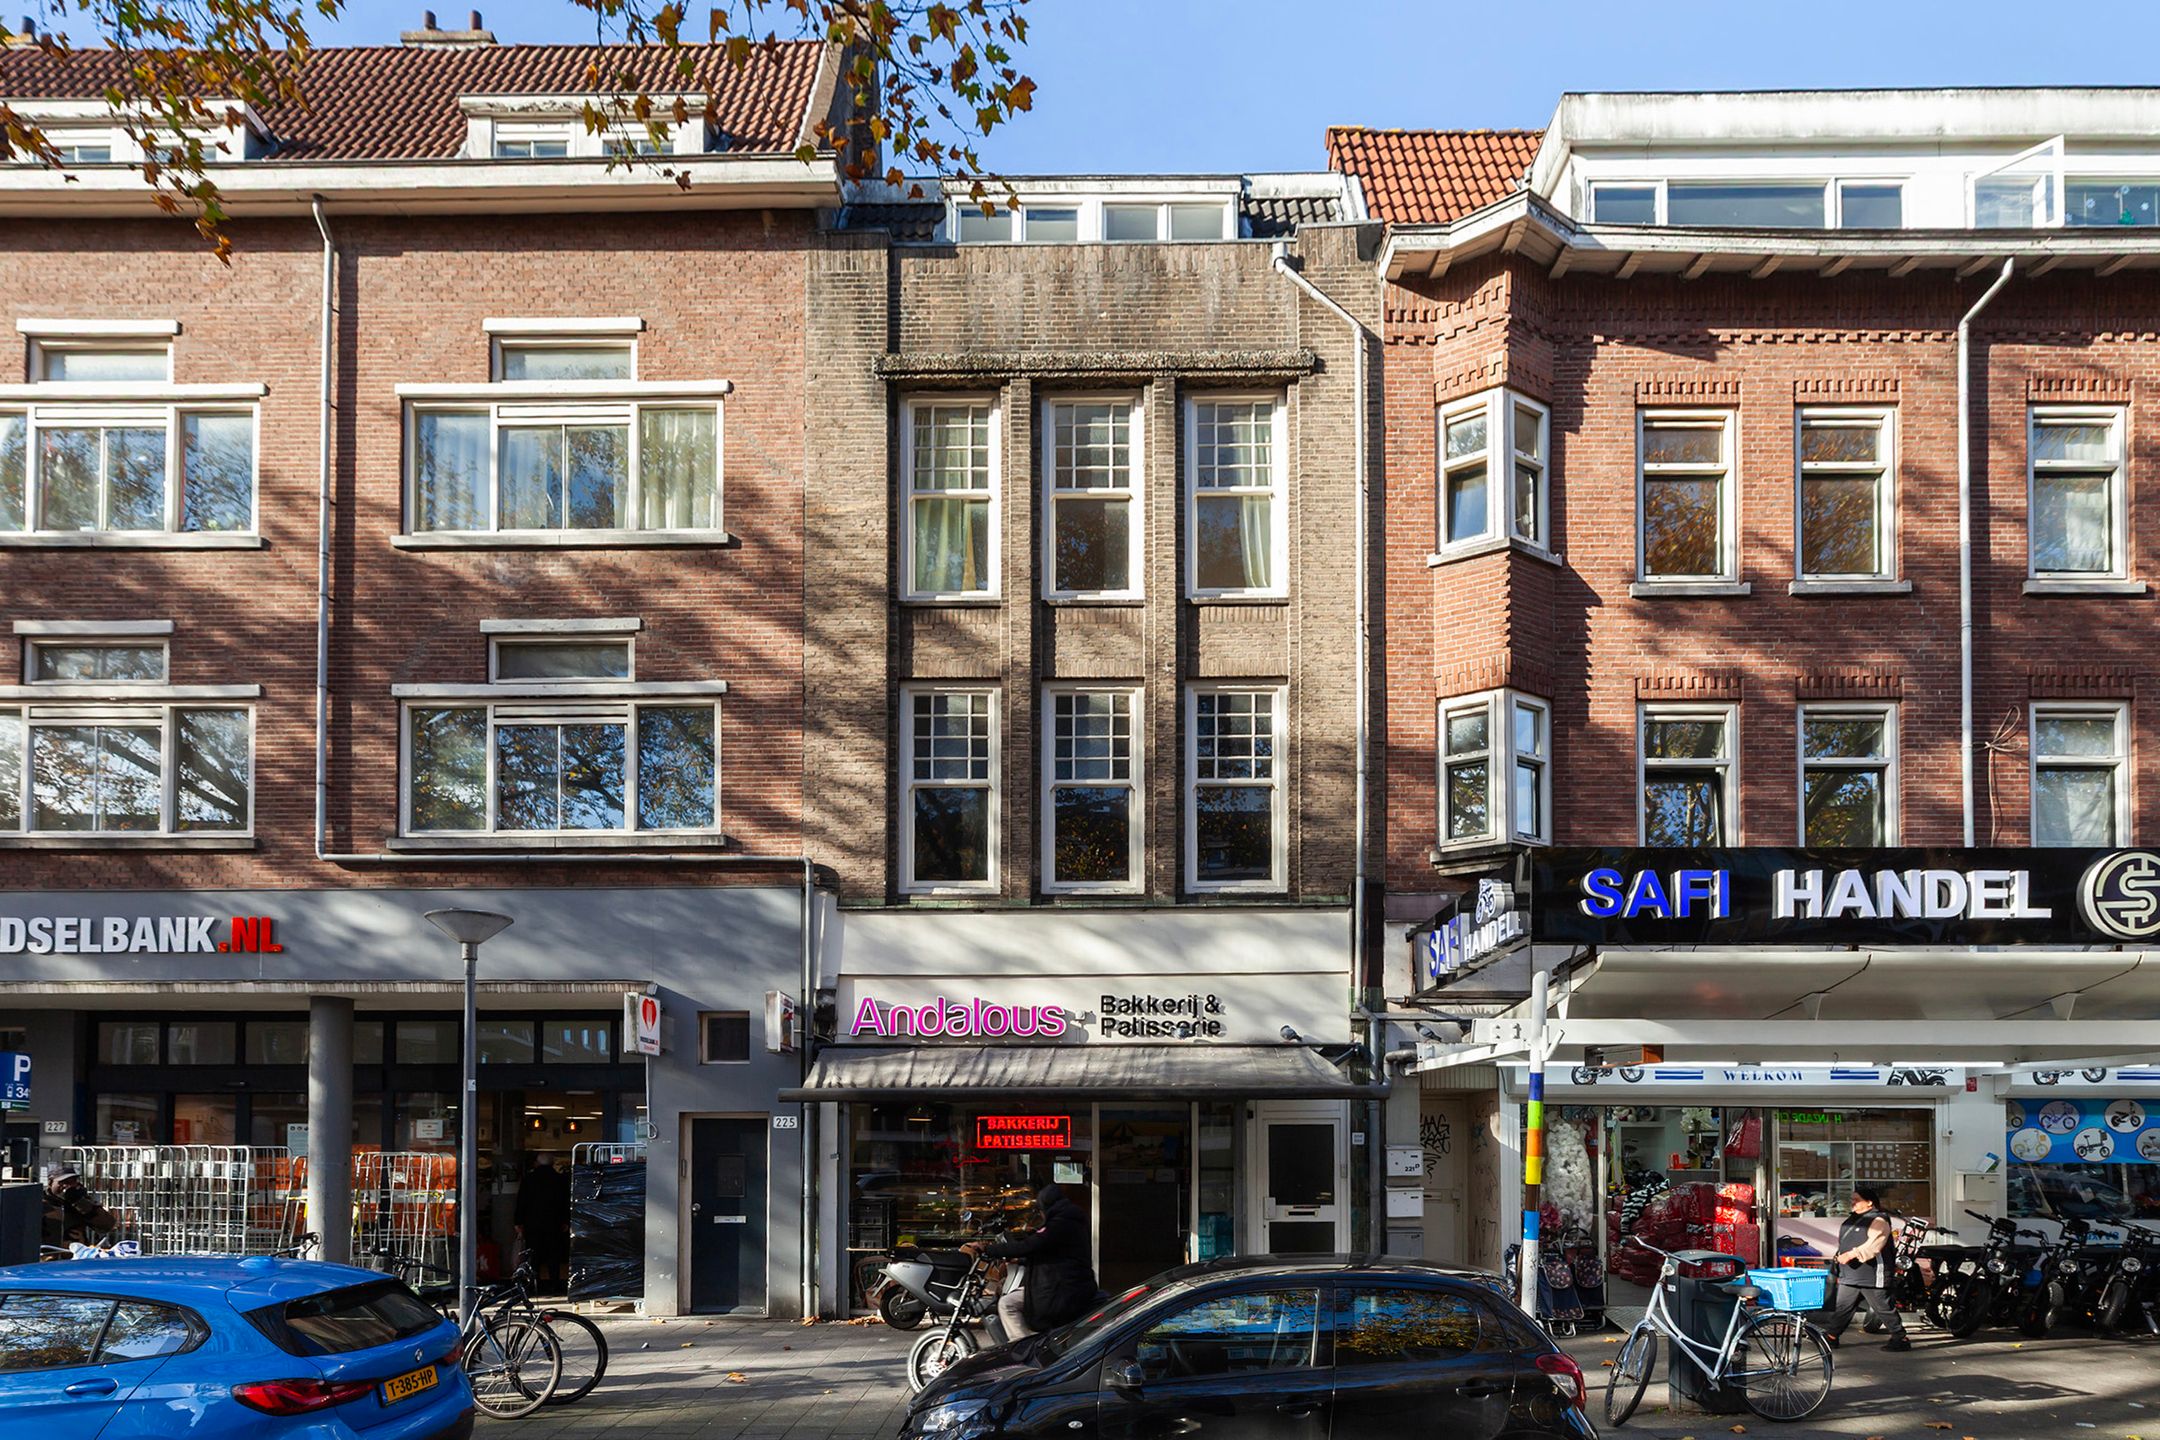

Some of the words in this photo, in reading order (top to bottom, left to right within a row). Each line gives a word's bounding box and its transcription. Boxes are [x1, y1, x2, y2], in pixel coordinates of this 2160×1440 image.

[1582, 869, 1729, 918] SAFI
[1774, 869, 2052, 918] HANDEL
[1429, 913, 1465, 977] SAFI
[1464, 911, 1518, 960] HANDEL
[849, 995, 1067, 1037] Andalous
[1101, 995, 1198, 1018] Bakkerij
[1205, 994, 1220, 1013] &
[1101, 1017, 1221, 1036] Patisserie
[14, 1055, 31, 1081] P
[1723, 1070, 1803, 1081] WELKOM
[47, 1122, 65, 1132] 227
[776, 1118, 796, 1128] 225
[987, 1118, 1060, 1130] BAKKERIJ
[983, 1134, 1065, 1146] PATISSERIE
[388, 1369, 433, 1397] T-385-HP
